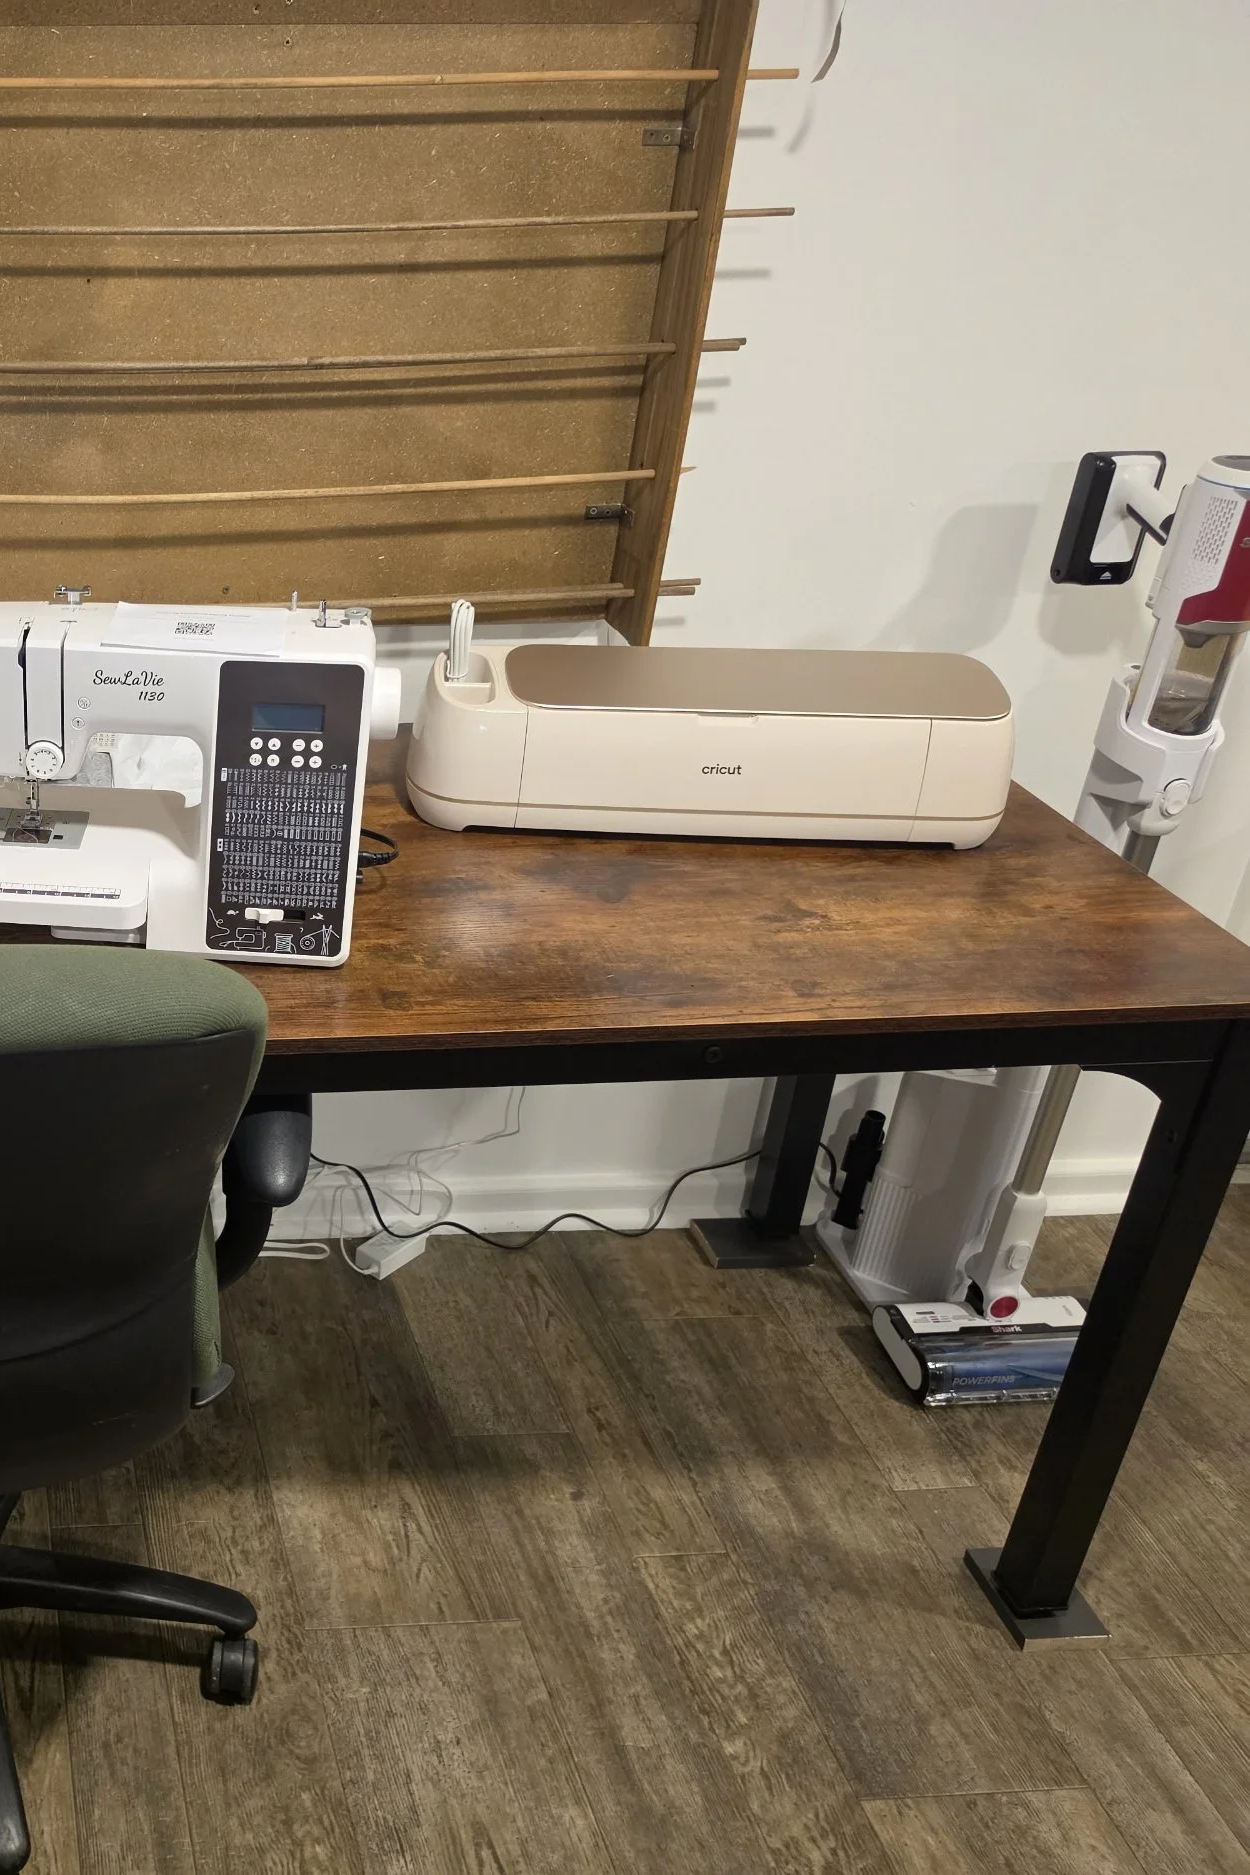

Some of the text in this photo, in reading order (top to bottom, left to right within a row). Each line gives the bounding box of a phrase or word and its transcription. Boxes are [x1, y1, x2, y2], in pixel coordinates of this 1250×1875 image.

[93, 669, 165, 687] SewLaVie
[138, 691, 165, 701] 1130
[701, 763, 742, 775] cricut
[991, 1325, 1022, 1333] Shark
[952, 1375, 1015, 1386] POWERFINS
